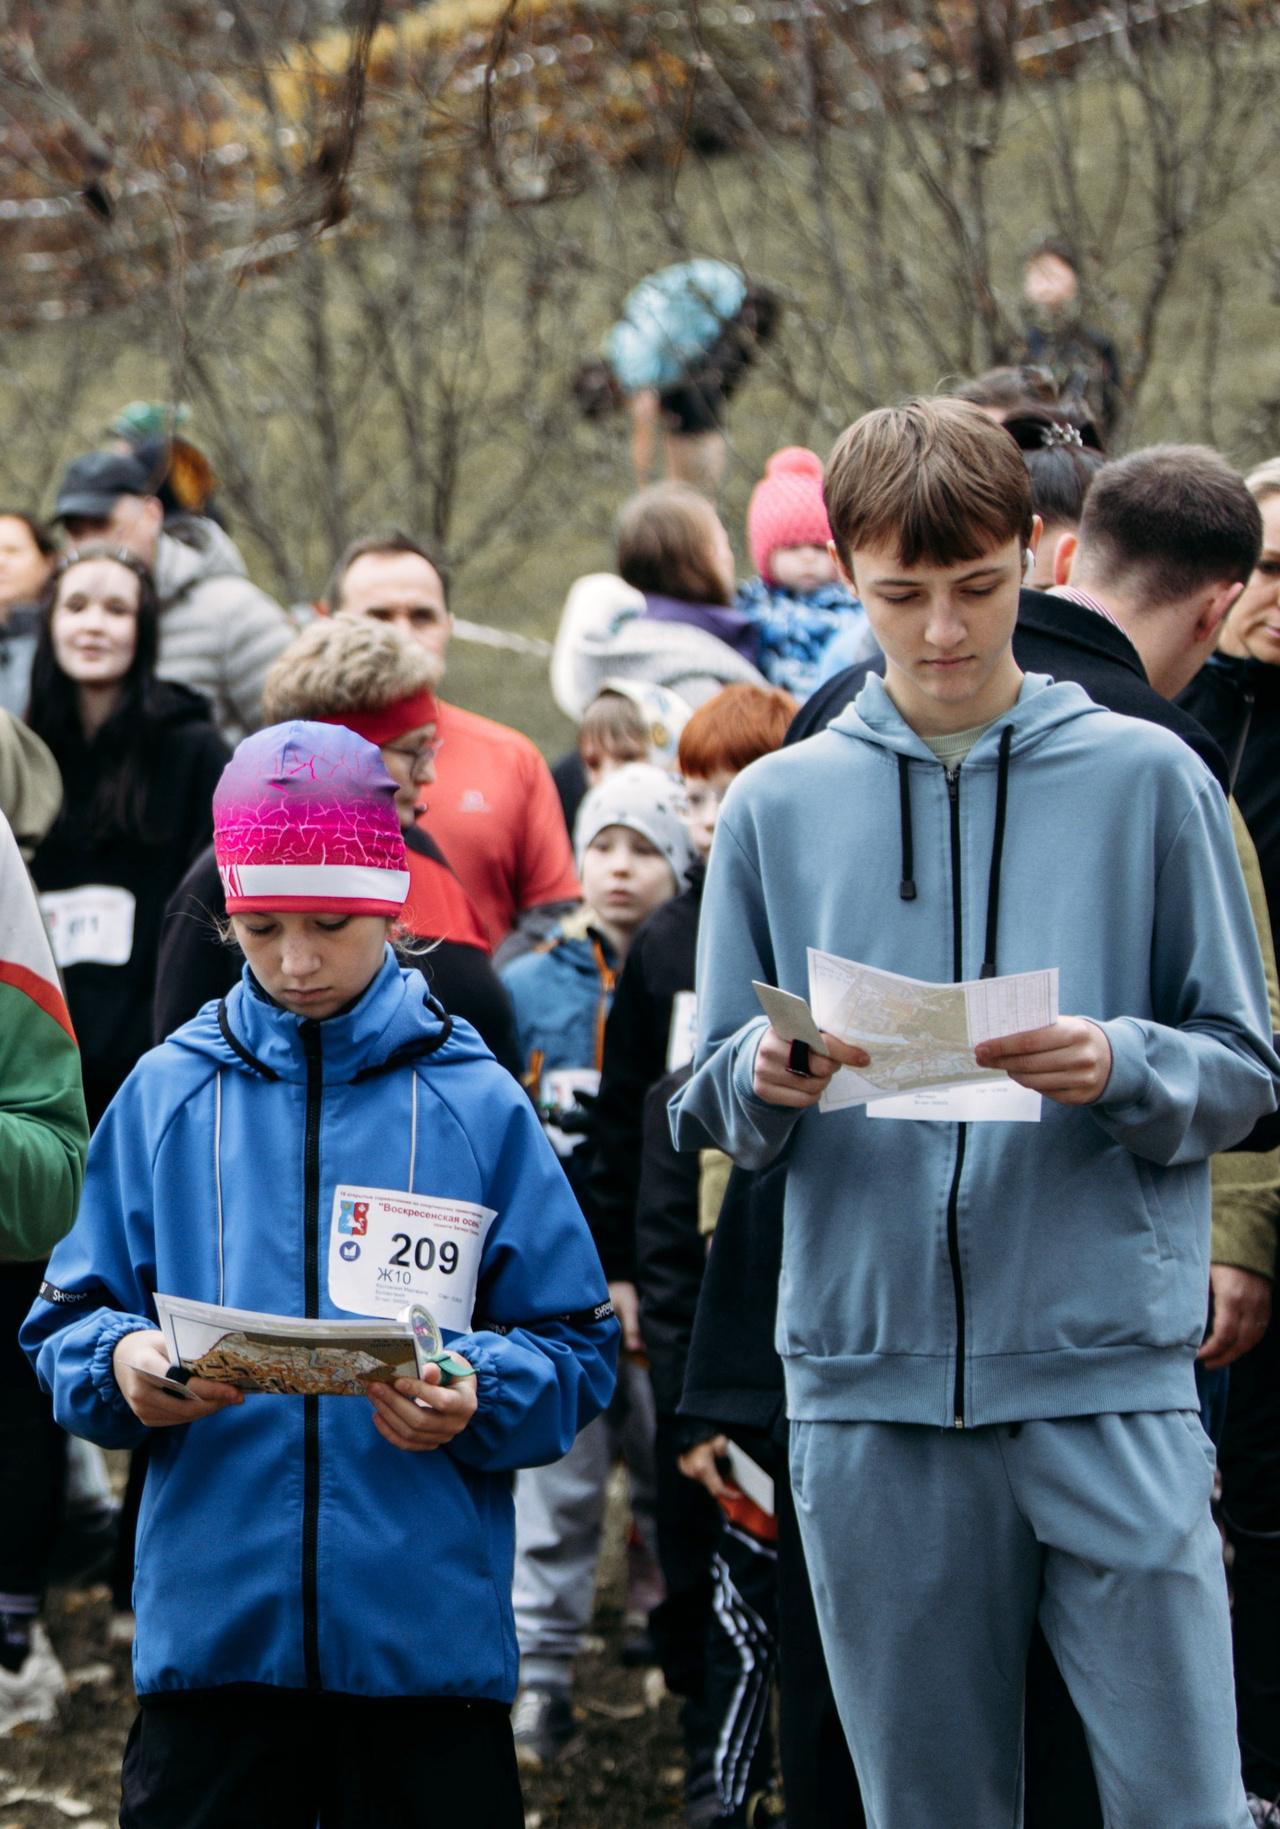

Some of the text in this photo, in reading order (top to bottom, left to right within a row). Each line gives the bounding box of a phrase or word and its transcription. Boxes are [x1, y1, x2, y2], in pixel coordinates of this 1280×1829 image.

[378, 1202, 460, 1223] "Воскресенская
[389, 1233, 459, 1275] 209
[377, 1267, 412, 1285] Ж10
